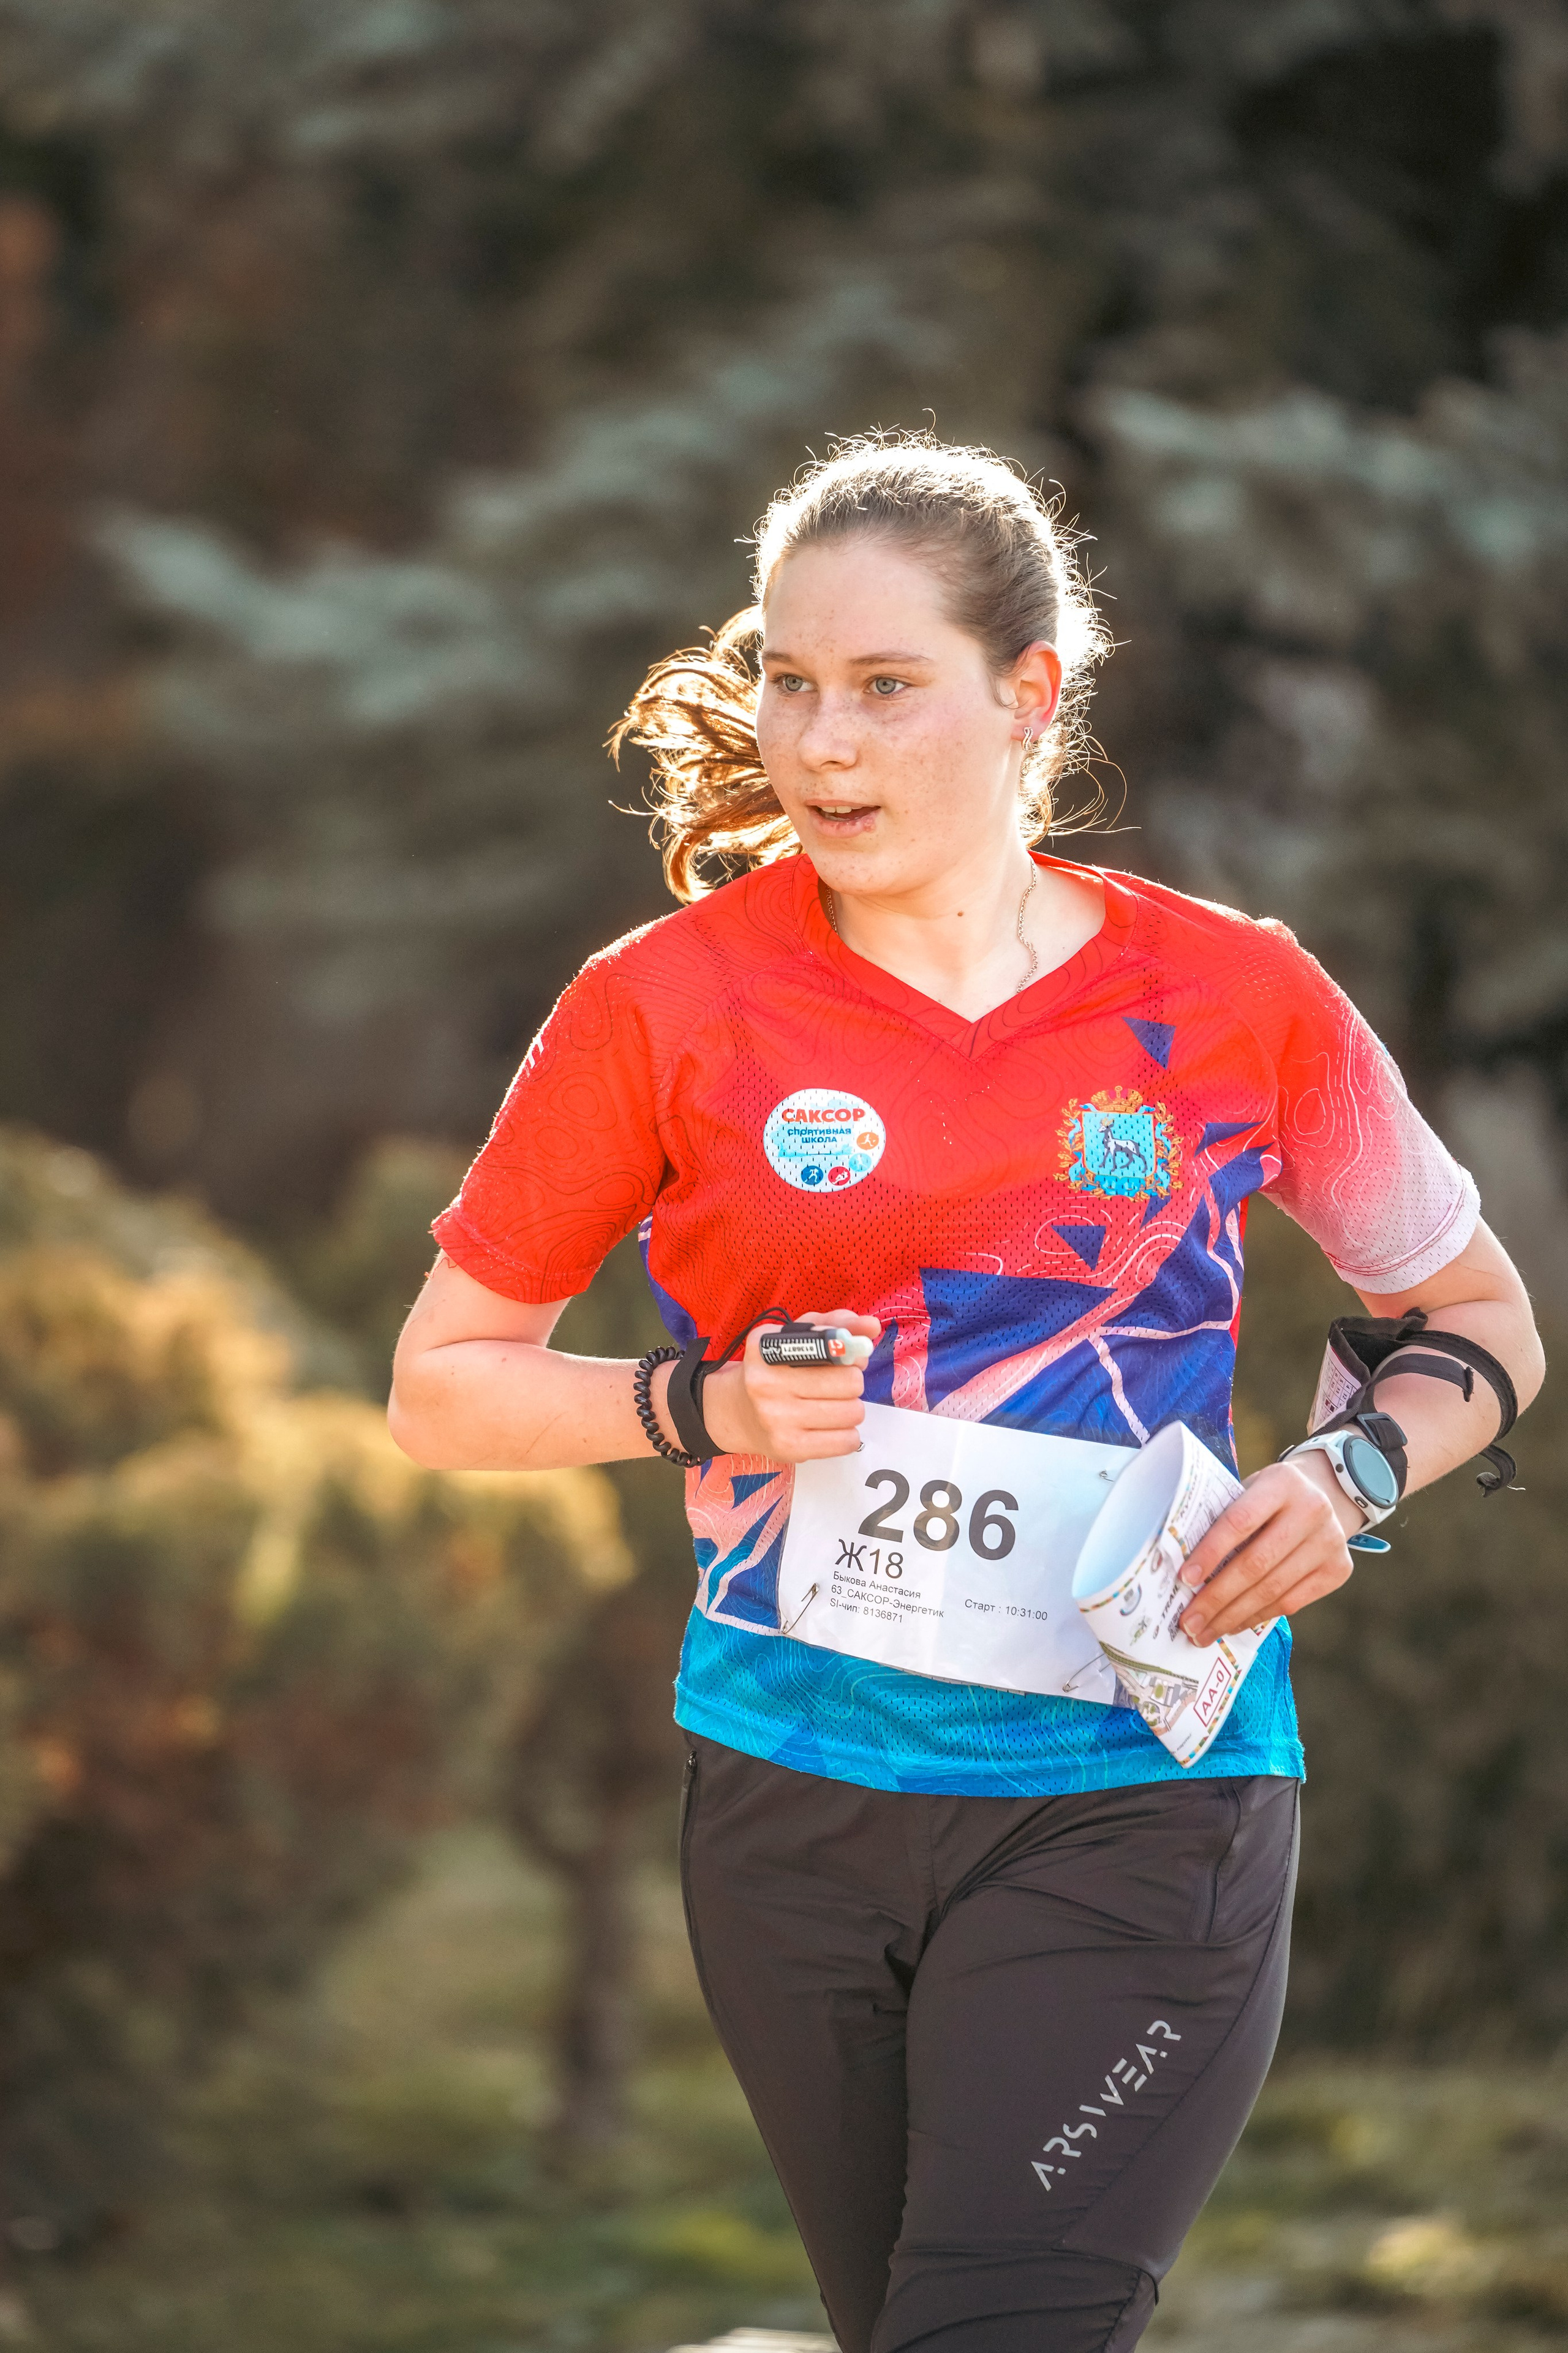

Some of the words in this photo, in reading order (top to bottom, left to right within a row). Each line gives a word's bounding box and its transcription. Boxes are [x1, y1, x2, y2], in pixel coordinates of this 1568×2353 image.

[782, 1108, 865, 1122] САКСОР
[858, 1469, 1019, 1560] 286
[834, 1538, 903, 1579] Ж18
[833, 1571, 867, 1587] Быкова
[869, 1580, 921, 1599] Анастасия
[829, 1598, 860, 1615] SI-чип:
[863, 1606, 903, 1623] 8136871
[831, 1584, 944, 1618] 63_САКСОР-Энергетик
[964, 1598, 997, 1614] Старт
[1005, 1606, 1048, 1621] 10:31:00
[1031, 2020, 1182, 2191] ARSWEAR
